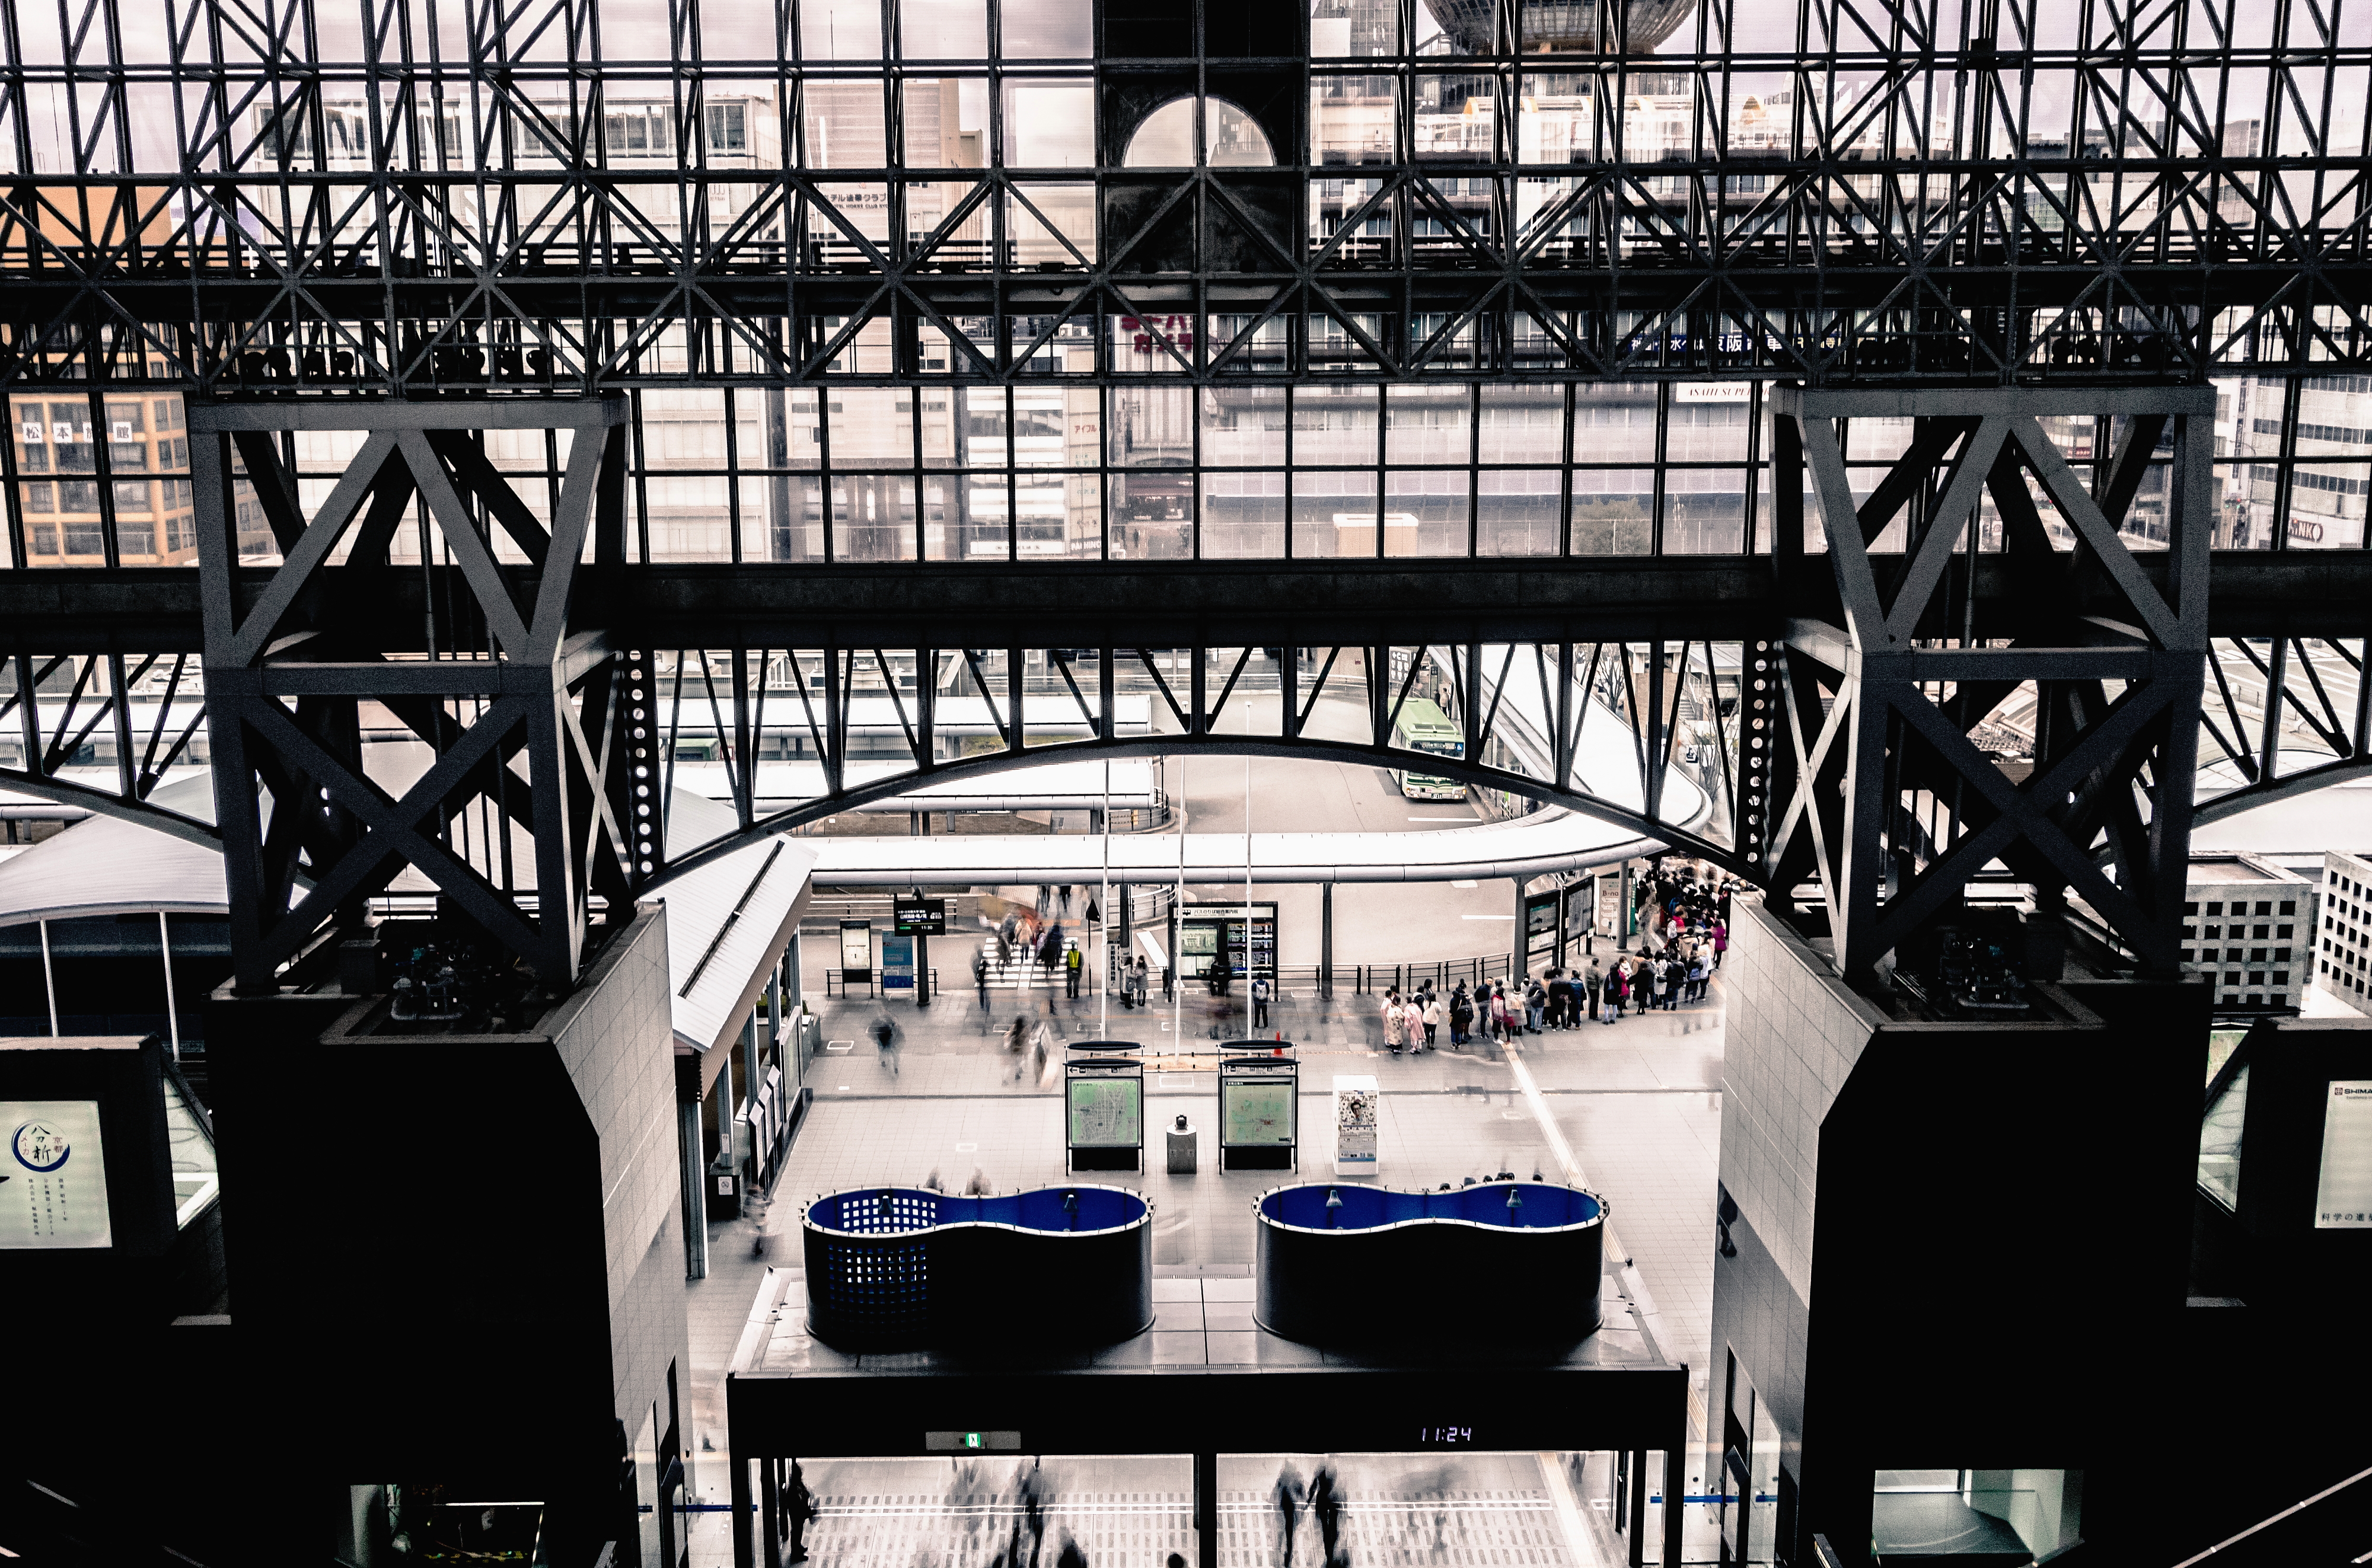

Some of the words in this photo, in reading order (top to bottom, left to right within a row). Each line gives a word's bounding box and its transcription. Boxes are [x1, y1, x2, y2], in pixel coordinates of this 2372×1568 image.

[1074, 424, 1097, 434] アイフル
[1421, 1426, 1472, 1442] 11:24
